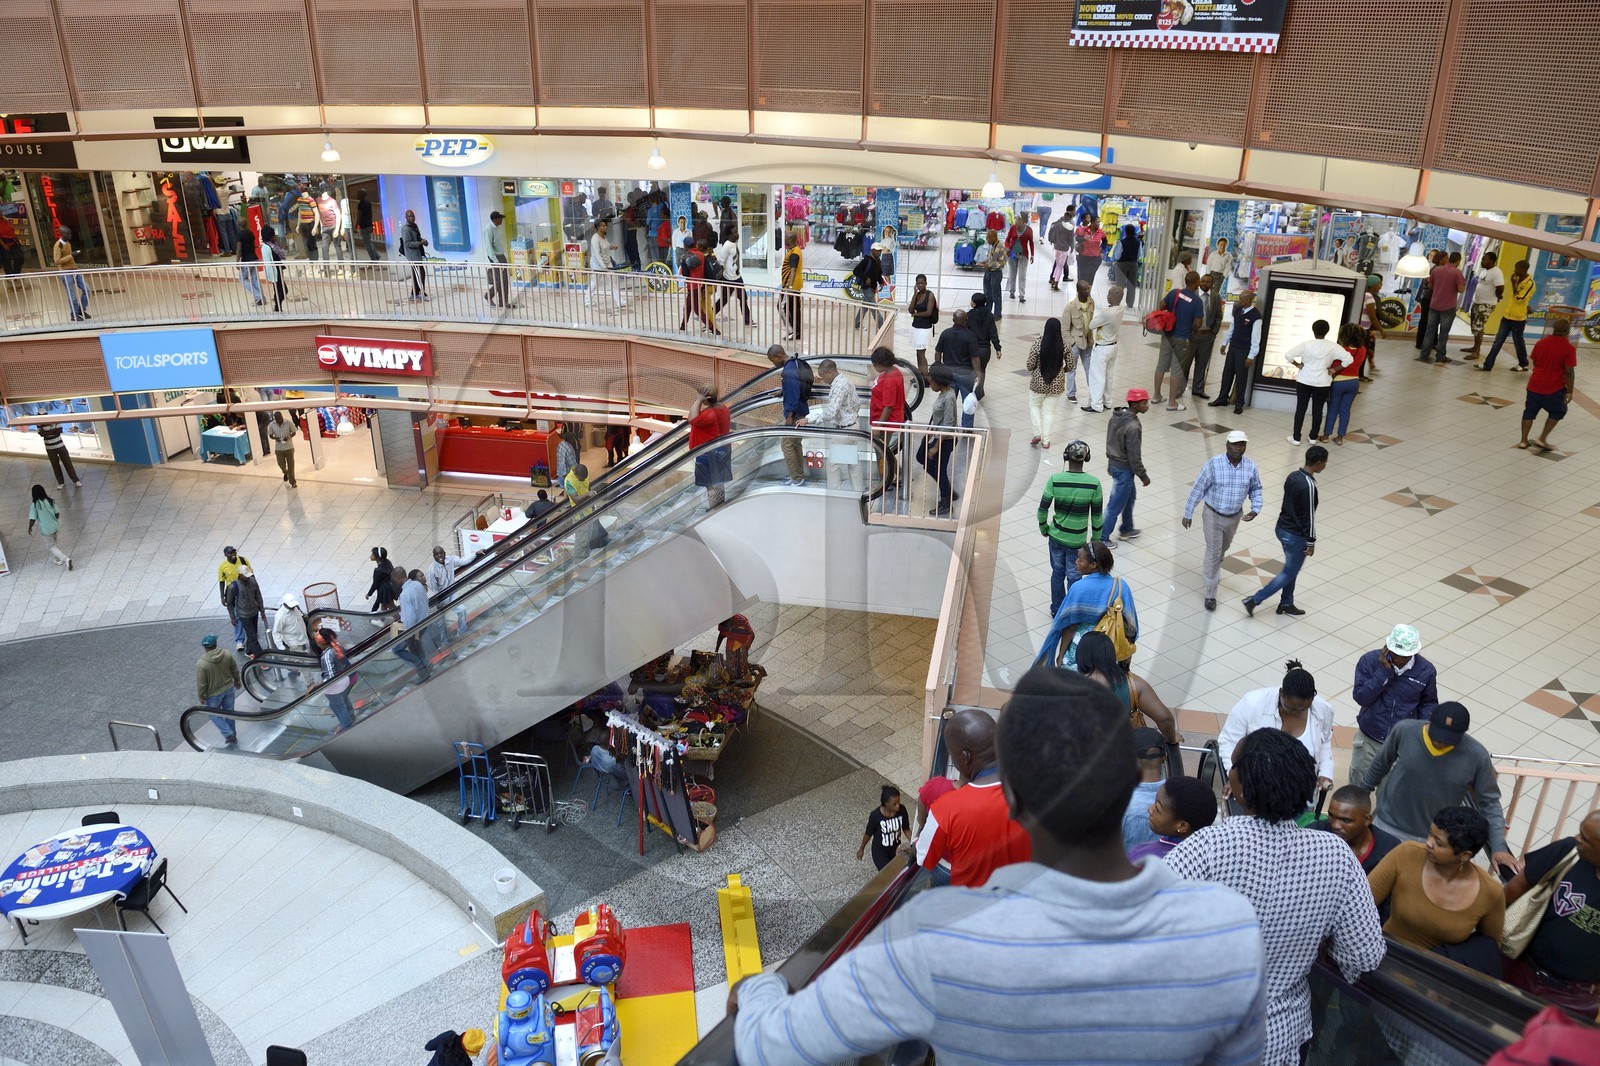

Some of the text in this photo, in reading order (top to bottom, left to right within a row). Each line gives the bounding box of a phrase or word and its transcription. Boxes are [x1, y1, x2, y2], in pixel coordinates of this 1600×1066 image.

[1158, 18, 1172, 26] R125
[0, 144, 43, 155] OUSE
[421, 138, 478, 157] PEP
[161, 183, 189, 259] SALE
[879, 219, 898, 227] KIDS
[135, 227, 166, 240] EXTRA
[807, 274, 829, 282] prices
[1382, 302, 1403, 317] STUDENT
[114, 351, 209, 370] TOTALSPORTS
[339, 345, 424, 371] WIMPY
[880, 816, 903, 834] SHUT
[19, 863, 78, 880] COLLEGE
